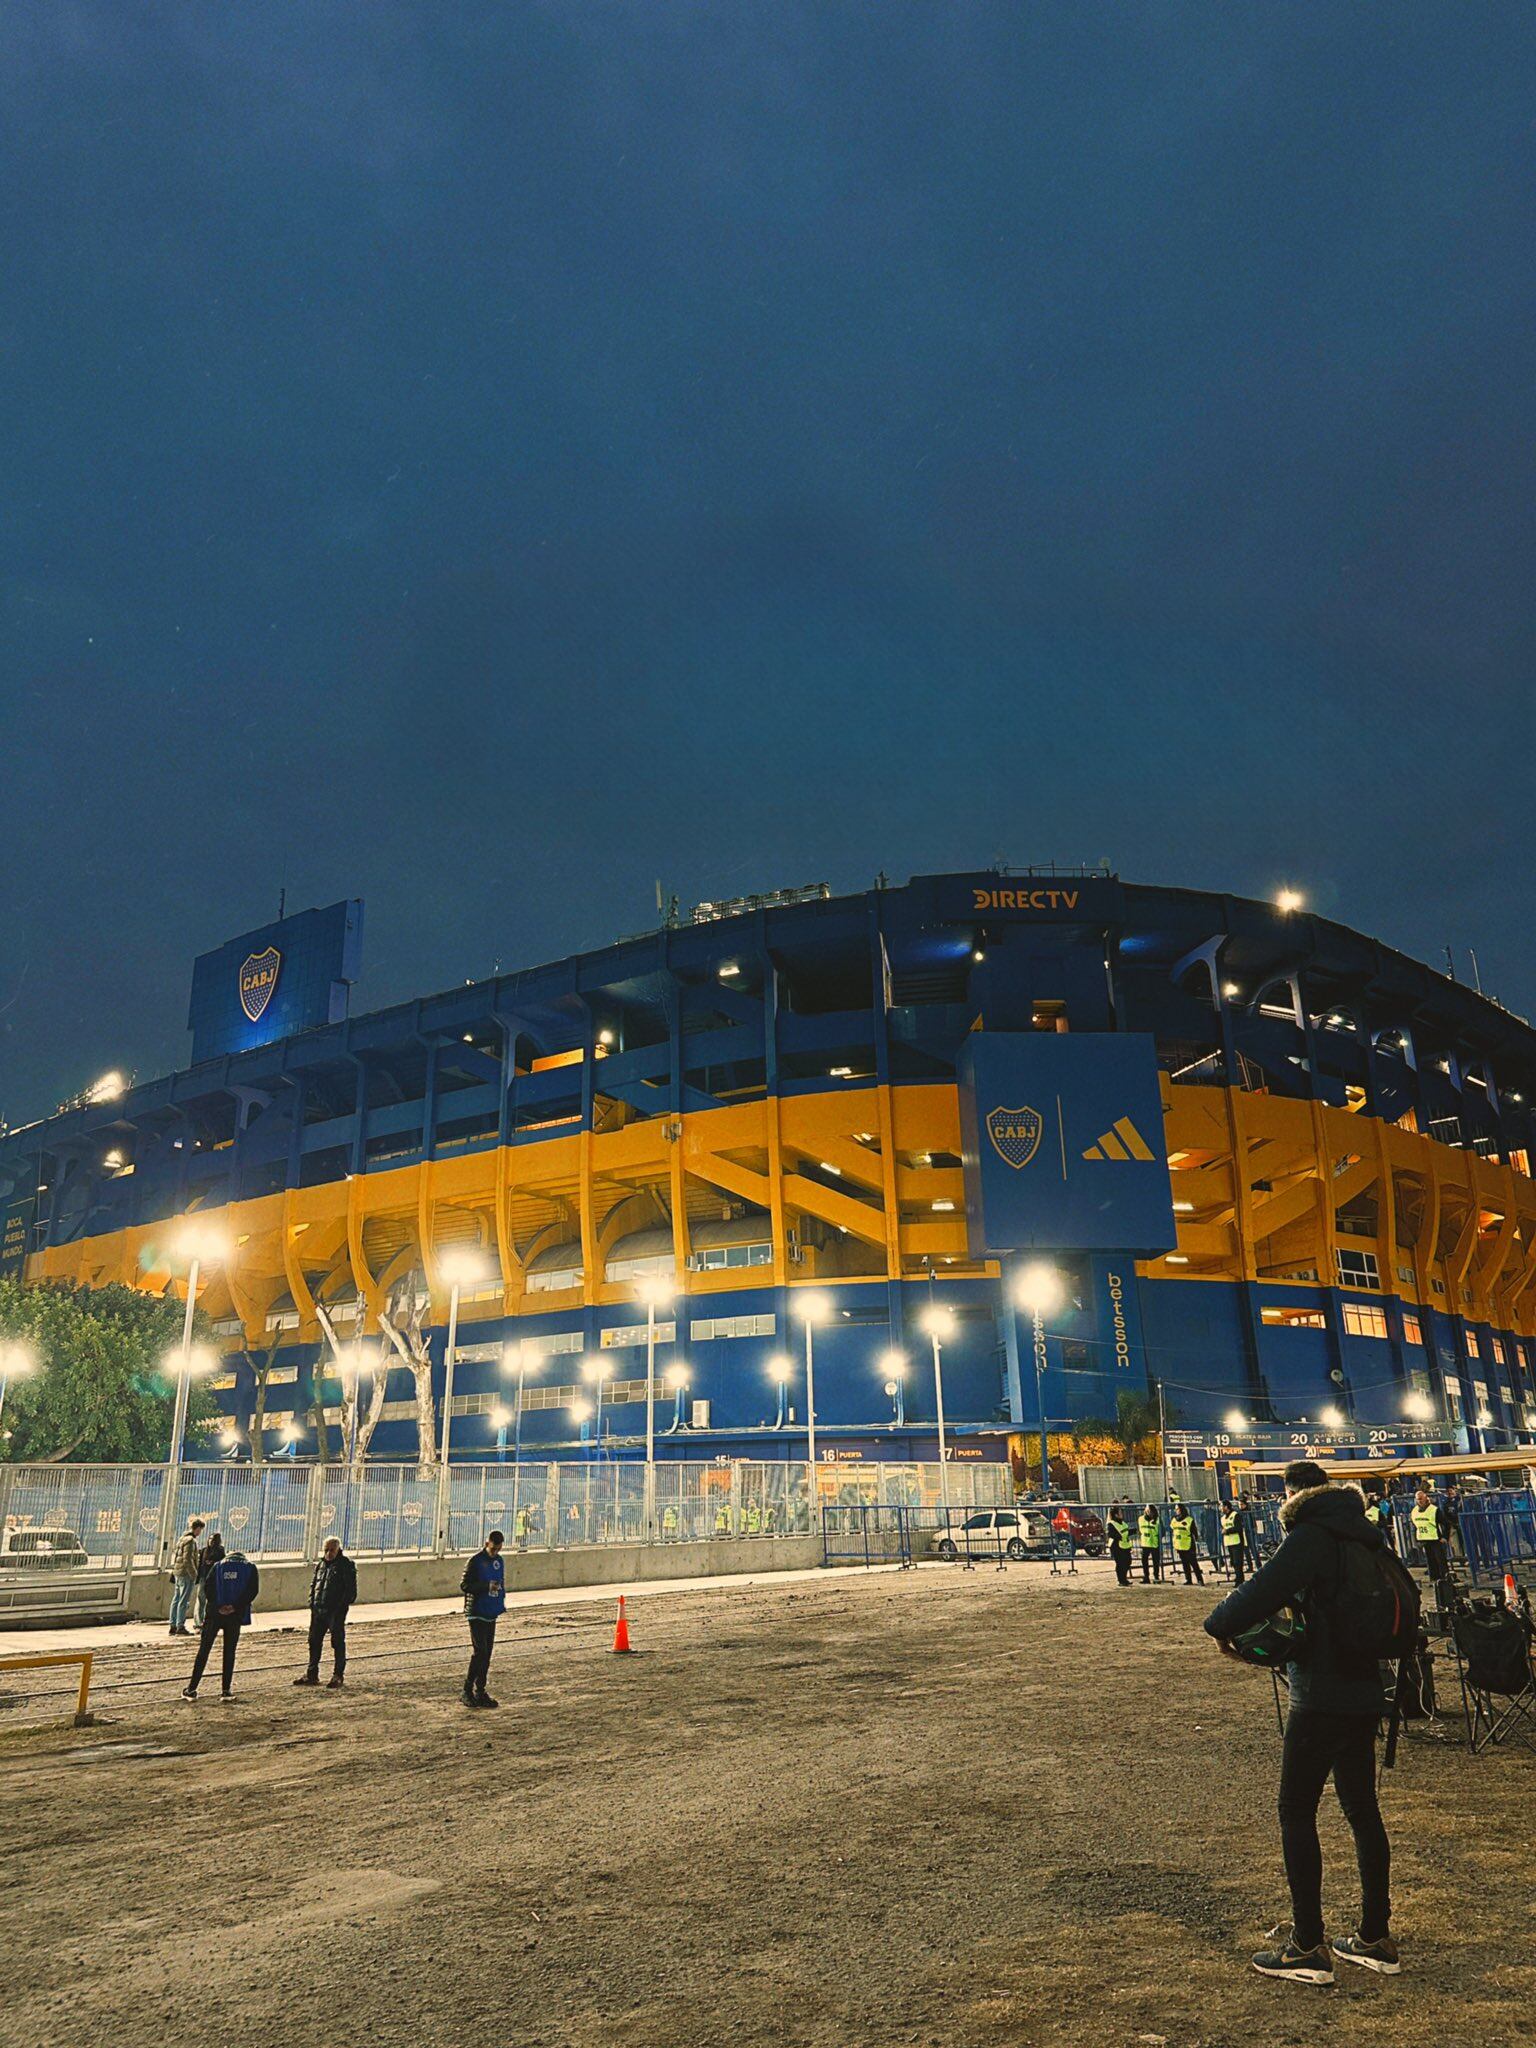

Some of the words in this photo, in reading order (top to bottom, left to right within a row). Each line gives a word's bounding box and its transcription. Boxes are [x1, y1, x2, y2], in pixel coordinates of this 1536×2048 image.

[972, 889, 1079, 909] DIRECTV
[243, 968, 275, 991] CABJ
[994, 1126, 1036, 1139] CABJ
[1107, 1272, 1130, 1367] betsson
[1215, 1434, 1230, 1446] 19
[1290, 1433, 1308, 1445] 20
[1369, 1430, 1387, 1442] 20
[821, 1449, 836, 1462] 16
[957, 1449, 983, 1457] PUERTA
[1205, 1446, 1219, 1459] 19
[1305, 1446, 1317, 1458] 20
